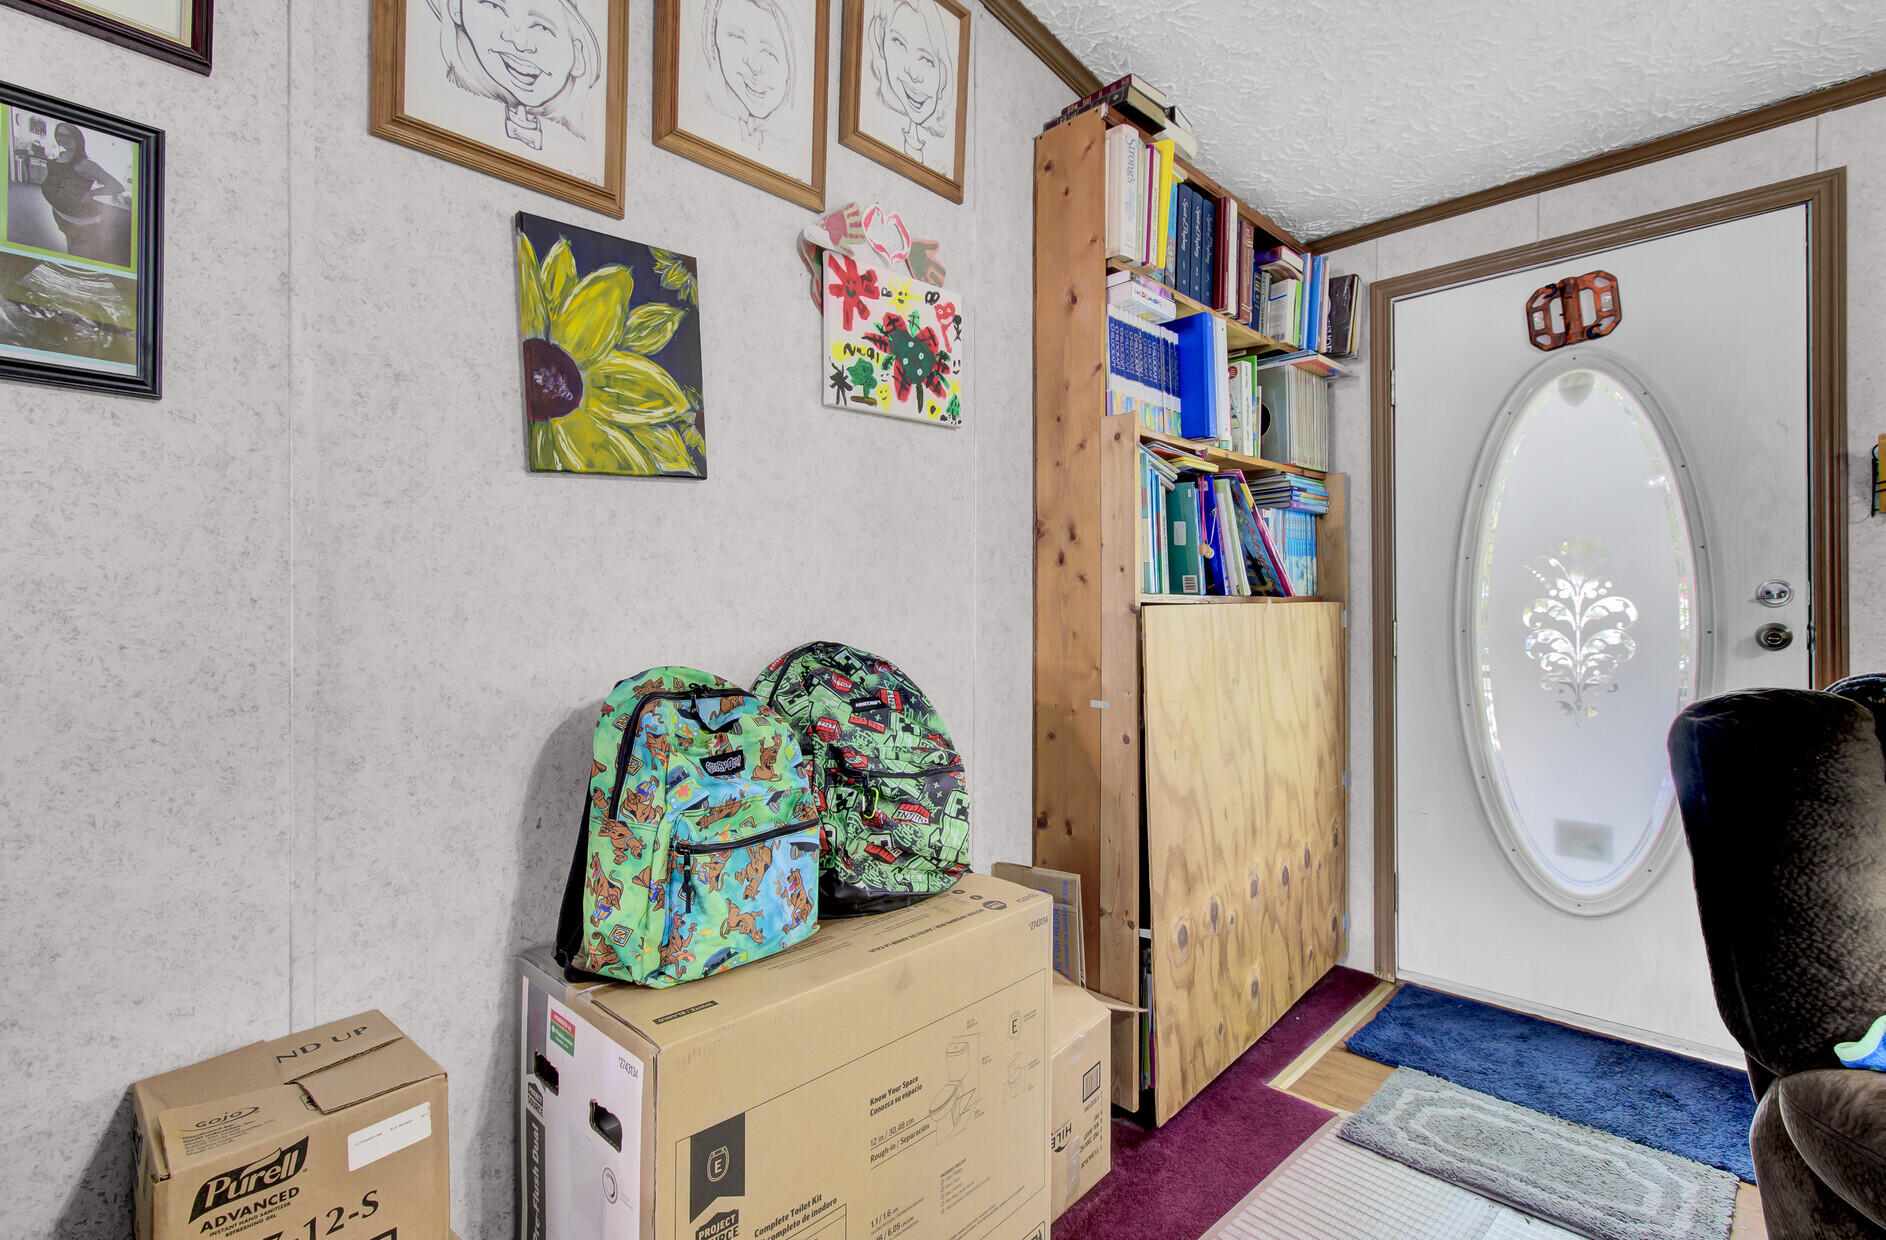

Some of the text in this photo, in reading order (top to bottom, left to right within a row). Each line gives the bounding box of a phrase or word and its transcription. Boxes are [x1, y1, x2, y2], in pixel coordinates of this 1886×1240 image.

[1126, 134, 1138, 185] Strong's
[1011, 1018, 1018, 1034] E
[276, 1025, 368, 1064] ND UP
[869, 1076, 919, 1106] Know Your Space
[869, 1100, 894, 1117] Conozca
[901, 1084, 923, 1100] espacio
[870, 1142, 896, 1164] Rough-in
[900, 1123, 930, 1146] Separación
[714, 1158, 723, 1174] E
[199, 1186, 301, 1234] ADVANCED
[209, 1201, 292, 1238] INSTANT HAND SANITIZER
[225, 1212, 278, 1238] REFRESHING GEL
[698, 1213, 737, 1239] PROJECT
[754, 1193, 823, 1238] Complete Toilet Kit
[767, 1197, 838, 1240] completo de inodoro
[887, 1222, 901, 1237] 6.05
